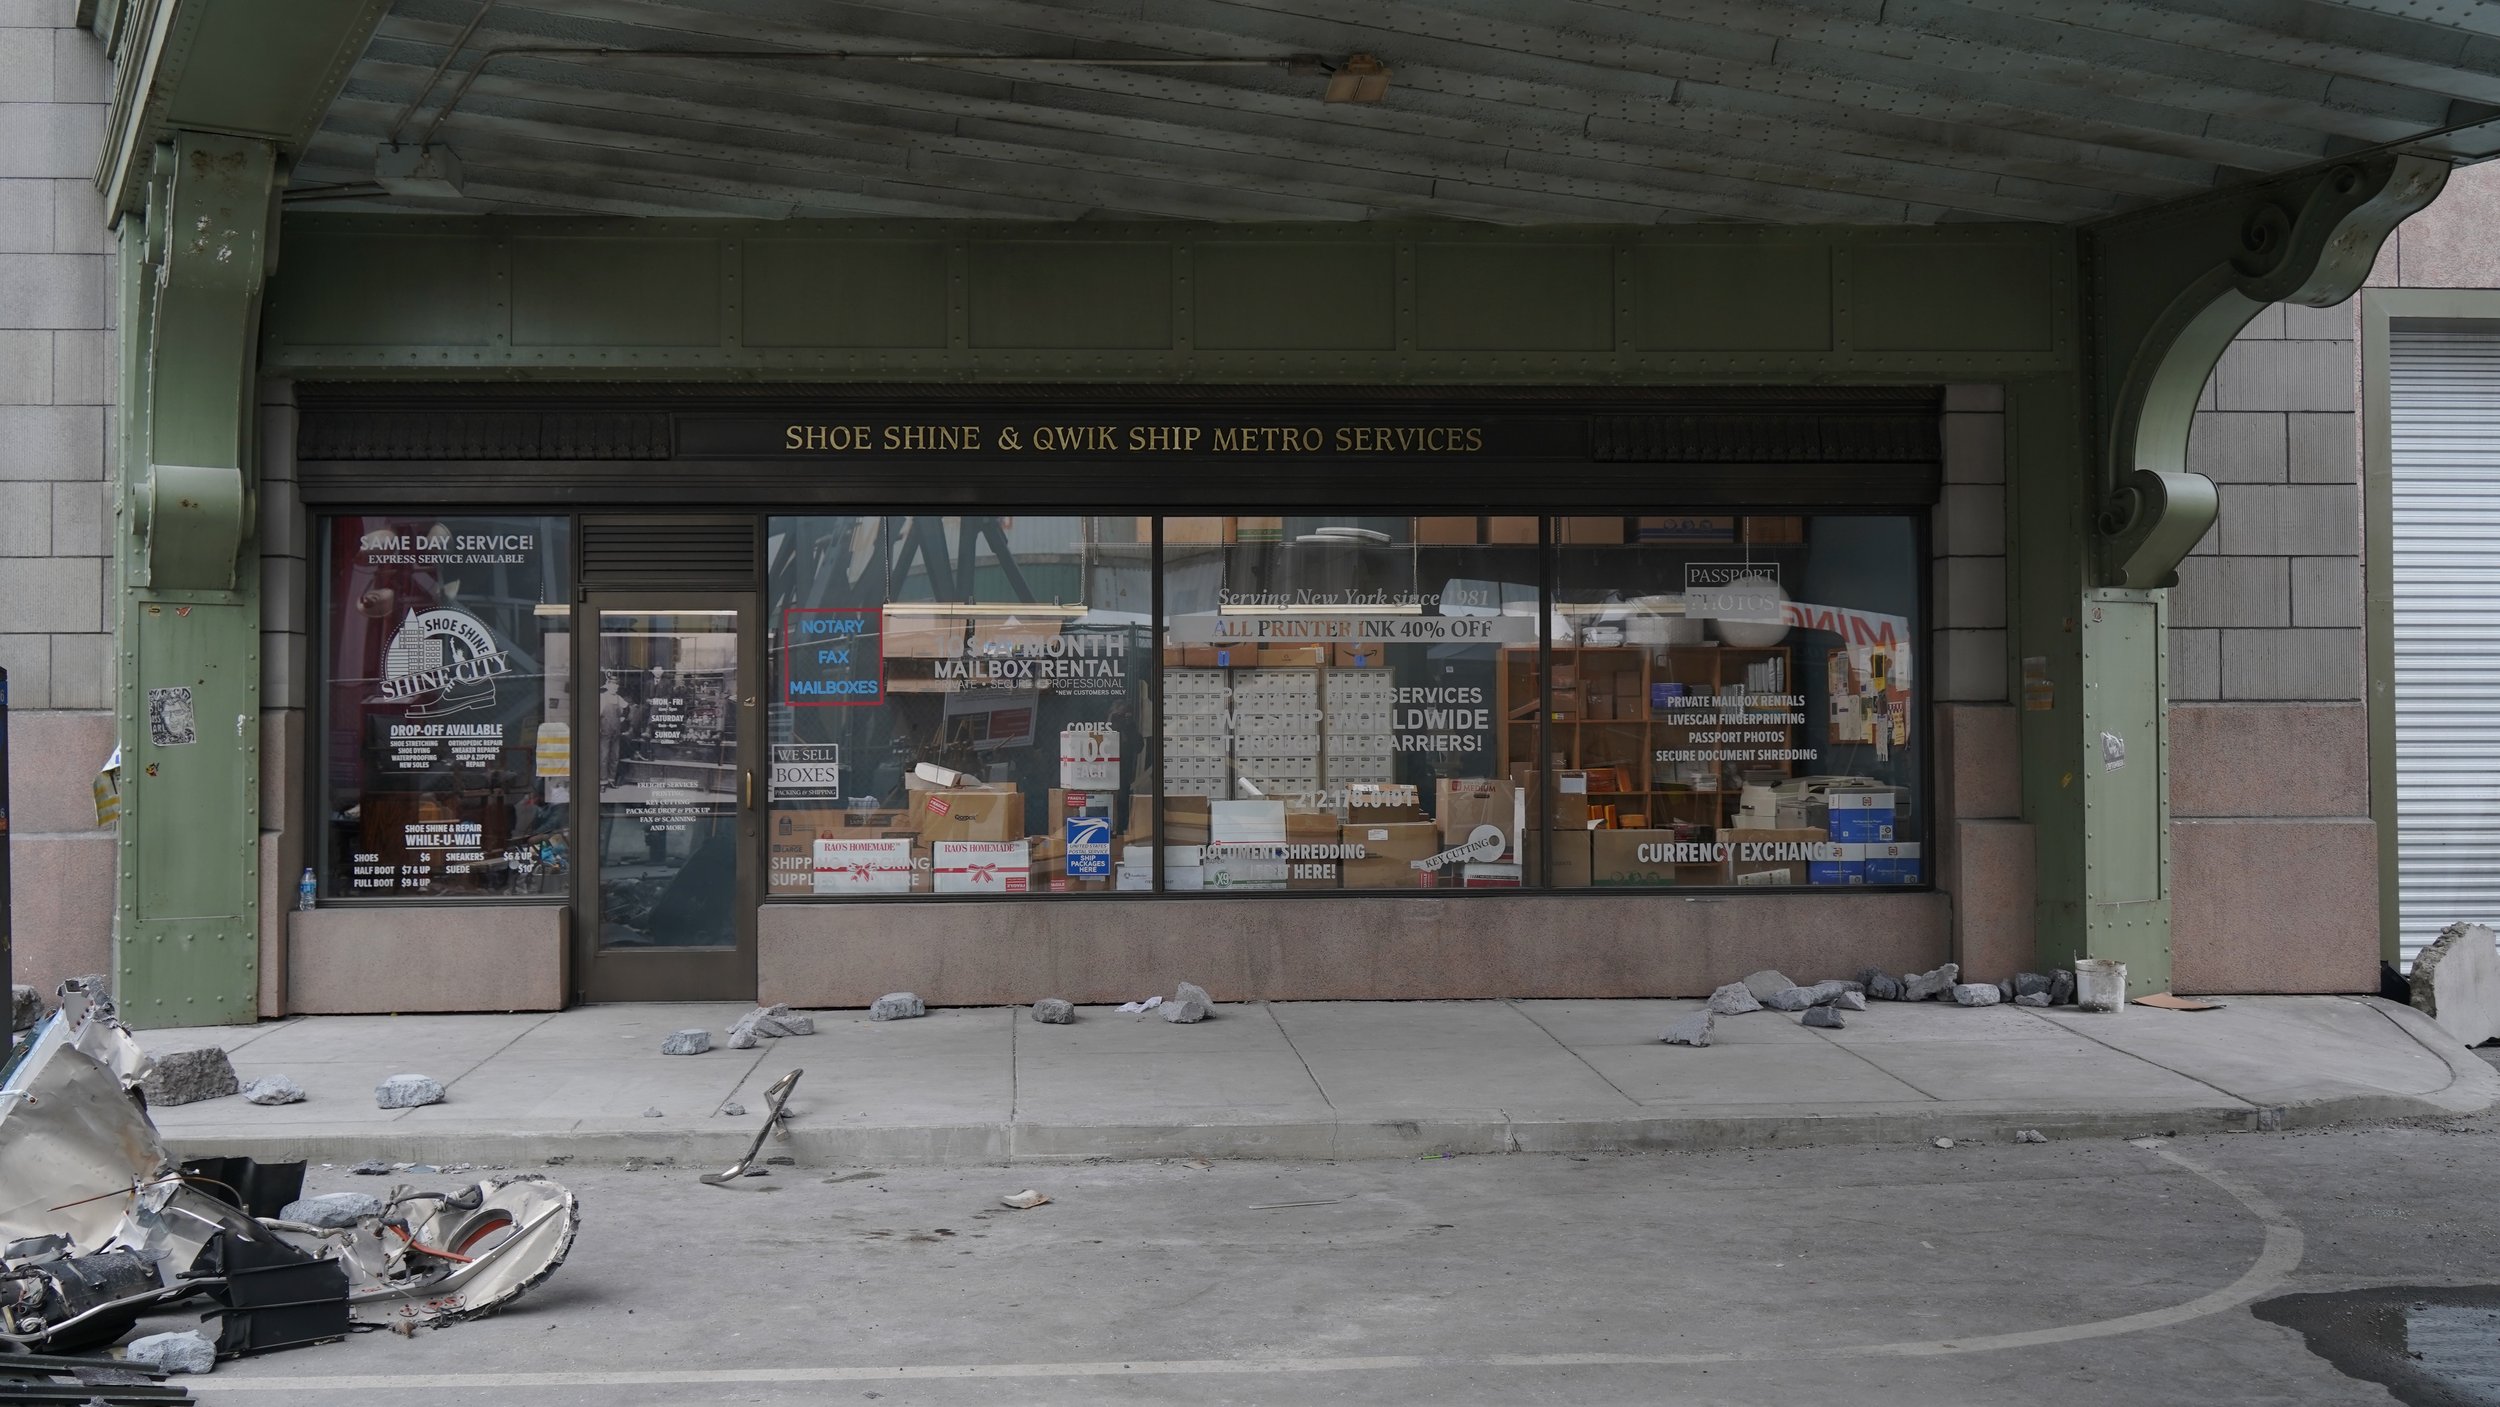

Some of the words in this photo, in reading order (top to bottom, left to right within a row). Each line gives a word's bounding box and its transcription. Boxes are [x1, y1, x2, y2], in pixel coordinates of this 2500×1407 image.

[785, 425, 874, 454] SHOE
[882, 425, 982, 454] SHINE
[998, 425, 1023, 454] &
[1032, 425, 1119, 454] QWIK
[1128, 425, 1201, 454] SHIP
[1211, 425, 1324, 454] METRO
[1334, 425, 1484, 454] SERVICES
[359, 535, 411, 550] SAME
[416, 535, 451, 550] DAY
[455, 535, 534, 550] SERVICE!
[368, 554, 416, 564] EXPRESS
[418, 554, 463, 564] SERVICE
[465, 554, 525, 564] AVAILABLE
[1690, 568, 1775, 584] PASSPORT
[1218, 588, 1291, 611] Serving
[1295, 588, 1339, 606] New
[1348, 588, 1388, 606] York
[1391, 588, 1440, 607] since
[1449, 590, 1488, 606] 981
[1691, 593, 1775, 611] PHOTOS
[801, 619, 865, 634] NOTARY
[1212, 620, 1254, 638] ALL
[1257, 620, 1351, 638] PRINTER
[1357, 620, 1396, 638] INK
[1399, 620, 1446, 638] 40%
[1450, 620, 1493, 638] OFF
[425, 617, 458, 632] SHOE
[458, 625, 490, 655] SHINE
[1021, 635, 1125, 658] MONTH
[818, 649, 850, 664] FAX
[934, 660, 1034, 679] MAILBOX
[1040, 660, 1126, 679] RENTAL
[381, 666, 450, 701] SHINE
[455, 653, 509, 685] CITY
[789, 680, 879, 695] MAILBOXES
[934, 679, 978, 689] PRIVATE
[990, 679, 1033, 689] SECURE
[1047, 679, 1123, 689] PROFESSIONAL
[1389, 687, 1483, 704] SERVICES
[1667, 696, 1710, 707] PRIVATE
[1711, 696, 1759, 707] MAILBOX
[1761, 696, 1806, 707] RENTALS
[651, 714, 685, 722] SATURDAY
[1667, 713, 1717, 725] LIVESCAN
[1719, 713, 1806, 725] FINGERPRINTING
[390, 724, 445, 736] DROP-OFF
[446, 724, 503, 736] AVAILABLE
[1067, 722, 1113, 734] COPIES
[1688, 731, 1742, 743] PASSPORT
[1743, 731, 1785, 743] PHOTOS
[777, 749, 800, 761] WE
[802, 749, 834, 761] SELL
[1655, 749, 1696, 761] SECURE
[1697, 749, 1756, 761] DOCUMENT
[1757, 749, 1818, 761] SHREDDING
[775, 767, 835, 783] BOXES
[1463, 784, 1496, 793] MEDIUM
[405, 825, 425, 833] SHOE
[425, 825, 448, 833] SHINE
[449, 825, 454, 833] &
[455, 825, 482, 833] REPAIR
[405, 834, 482, 847] WHILE-U-WAIT
[823, 843, 848, 853] RAO'S
[849, 843, 896, 853] HOMEMADE
[943, 844, 968, 853] RAO'S
[969, 844, 1016, 853] HOMEMADE
[1199, 844, 1277, 860] DOCUMENT
[1281, 844, 1366, 860] SHREDDING
[1425, 856, 1447, 869] KEY
[1446, 838, 1489, 861] CUTTING
[1637, 842, 1736, 862] CURRENCY
[354, 854, 379, 862] SHOES
[420, 852, 431, 862] $6
[445, 852, 485, 862] SNEAKERS
[503, 852, 513, 861] $6
[521, 852, 533, 860] UP
[354, 866, 374, 875] HALF
[374, 866, 395, 875] BOOT
[402, 866, 412, 875] $7
[412, 866, 419, 875] &
[420, 866, 431, 875] UP
[445, 865, 471, 874] SUEDE
[518, 864, 532, 874] $10
[1293, 864, 1337, 880] HERE!
[354, 879, 373, 888] FULL
[373, 879, 395, 888] BOOT
[401, 879, 412, 888] $9
[412, 879, 419, 888] &
[420, 879, 431, 888] UP
[1217, 873, 1230, 885] X9
